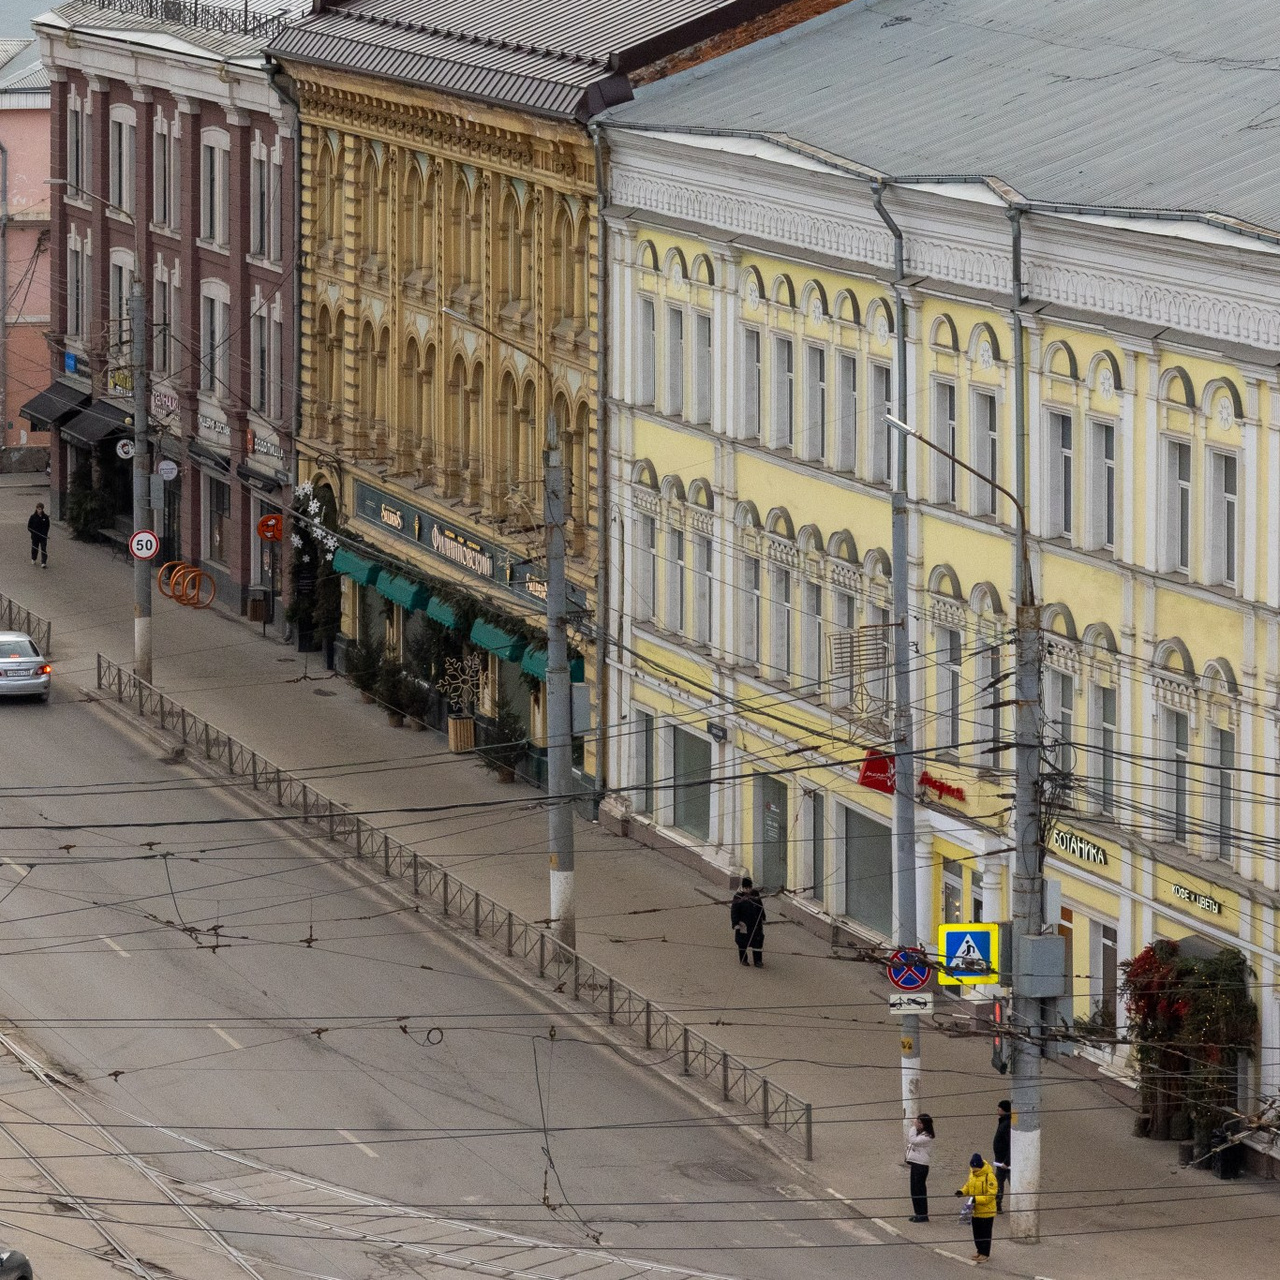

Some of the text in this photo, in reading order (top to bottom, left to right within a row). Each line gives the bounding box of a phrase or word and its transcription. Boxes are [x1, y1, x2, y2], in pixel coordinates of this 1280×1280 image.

[136, 539, 153, 551] 50
[1053, 829, 1105, 866] БОТАНИКА
[1172, 884, 1190, 902] КОФЕ
[1196, 895, 1219, 914] ЦВЕТЫ
